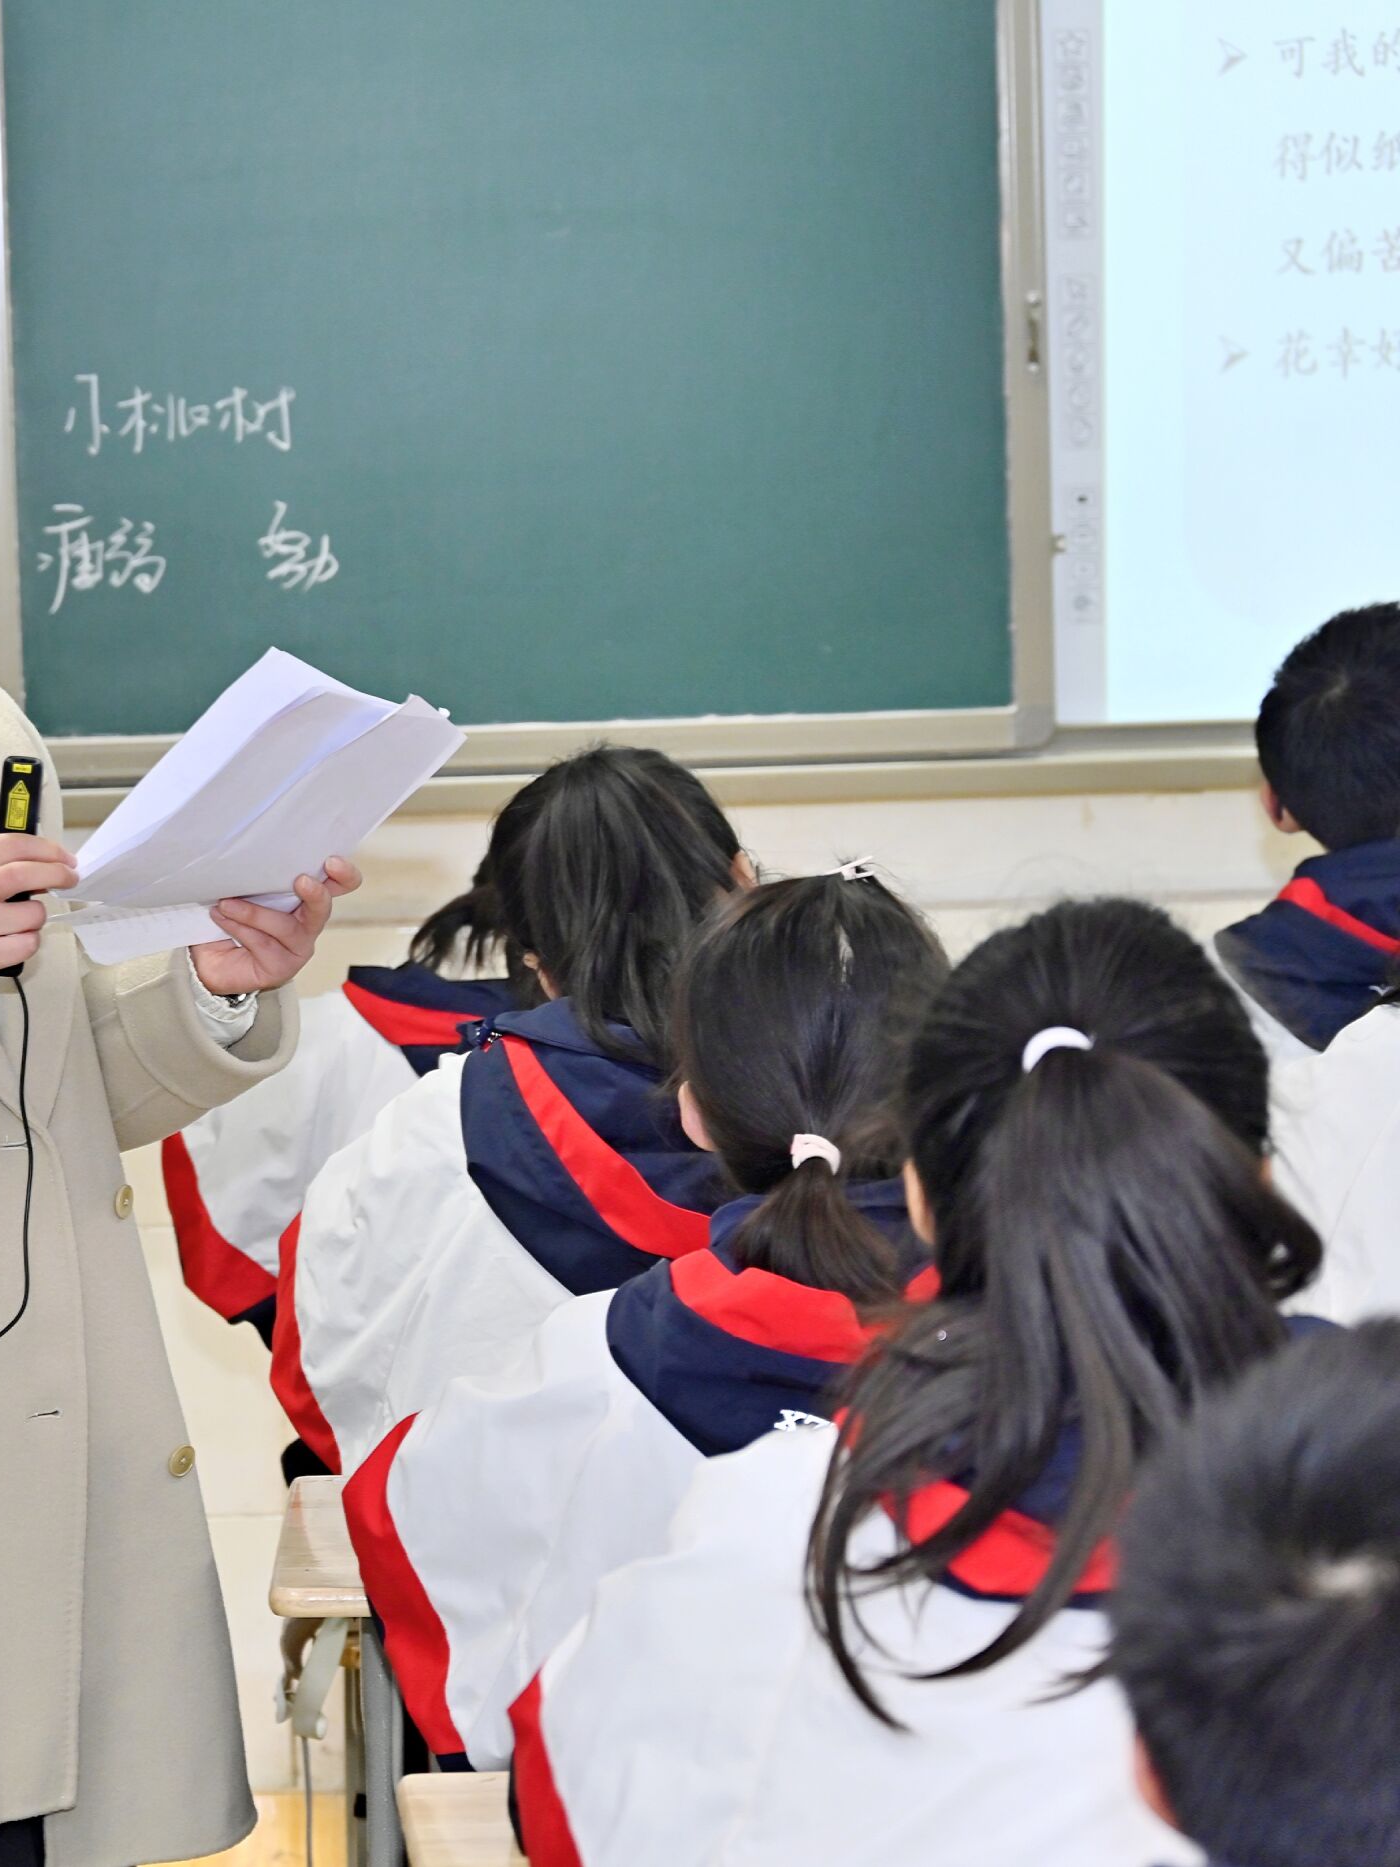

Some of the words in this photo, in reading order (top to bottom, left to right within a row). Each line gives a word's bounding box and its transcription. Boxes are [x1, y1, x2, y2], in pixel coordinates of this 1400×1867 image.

[1274, 27, 1400, 79] 可我的
[64, 373, 297, 455] 小桃树
